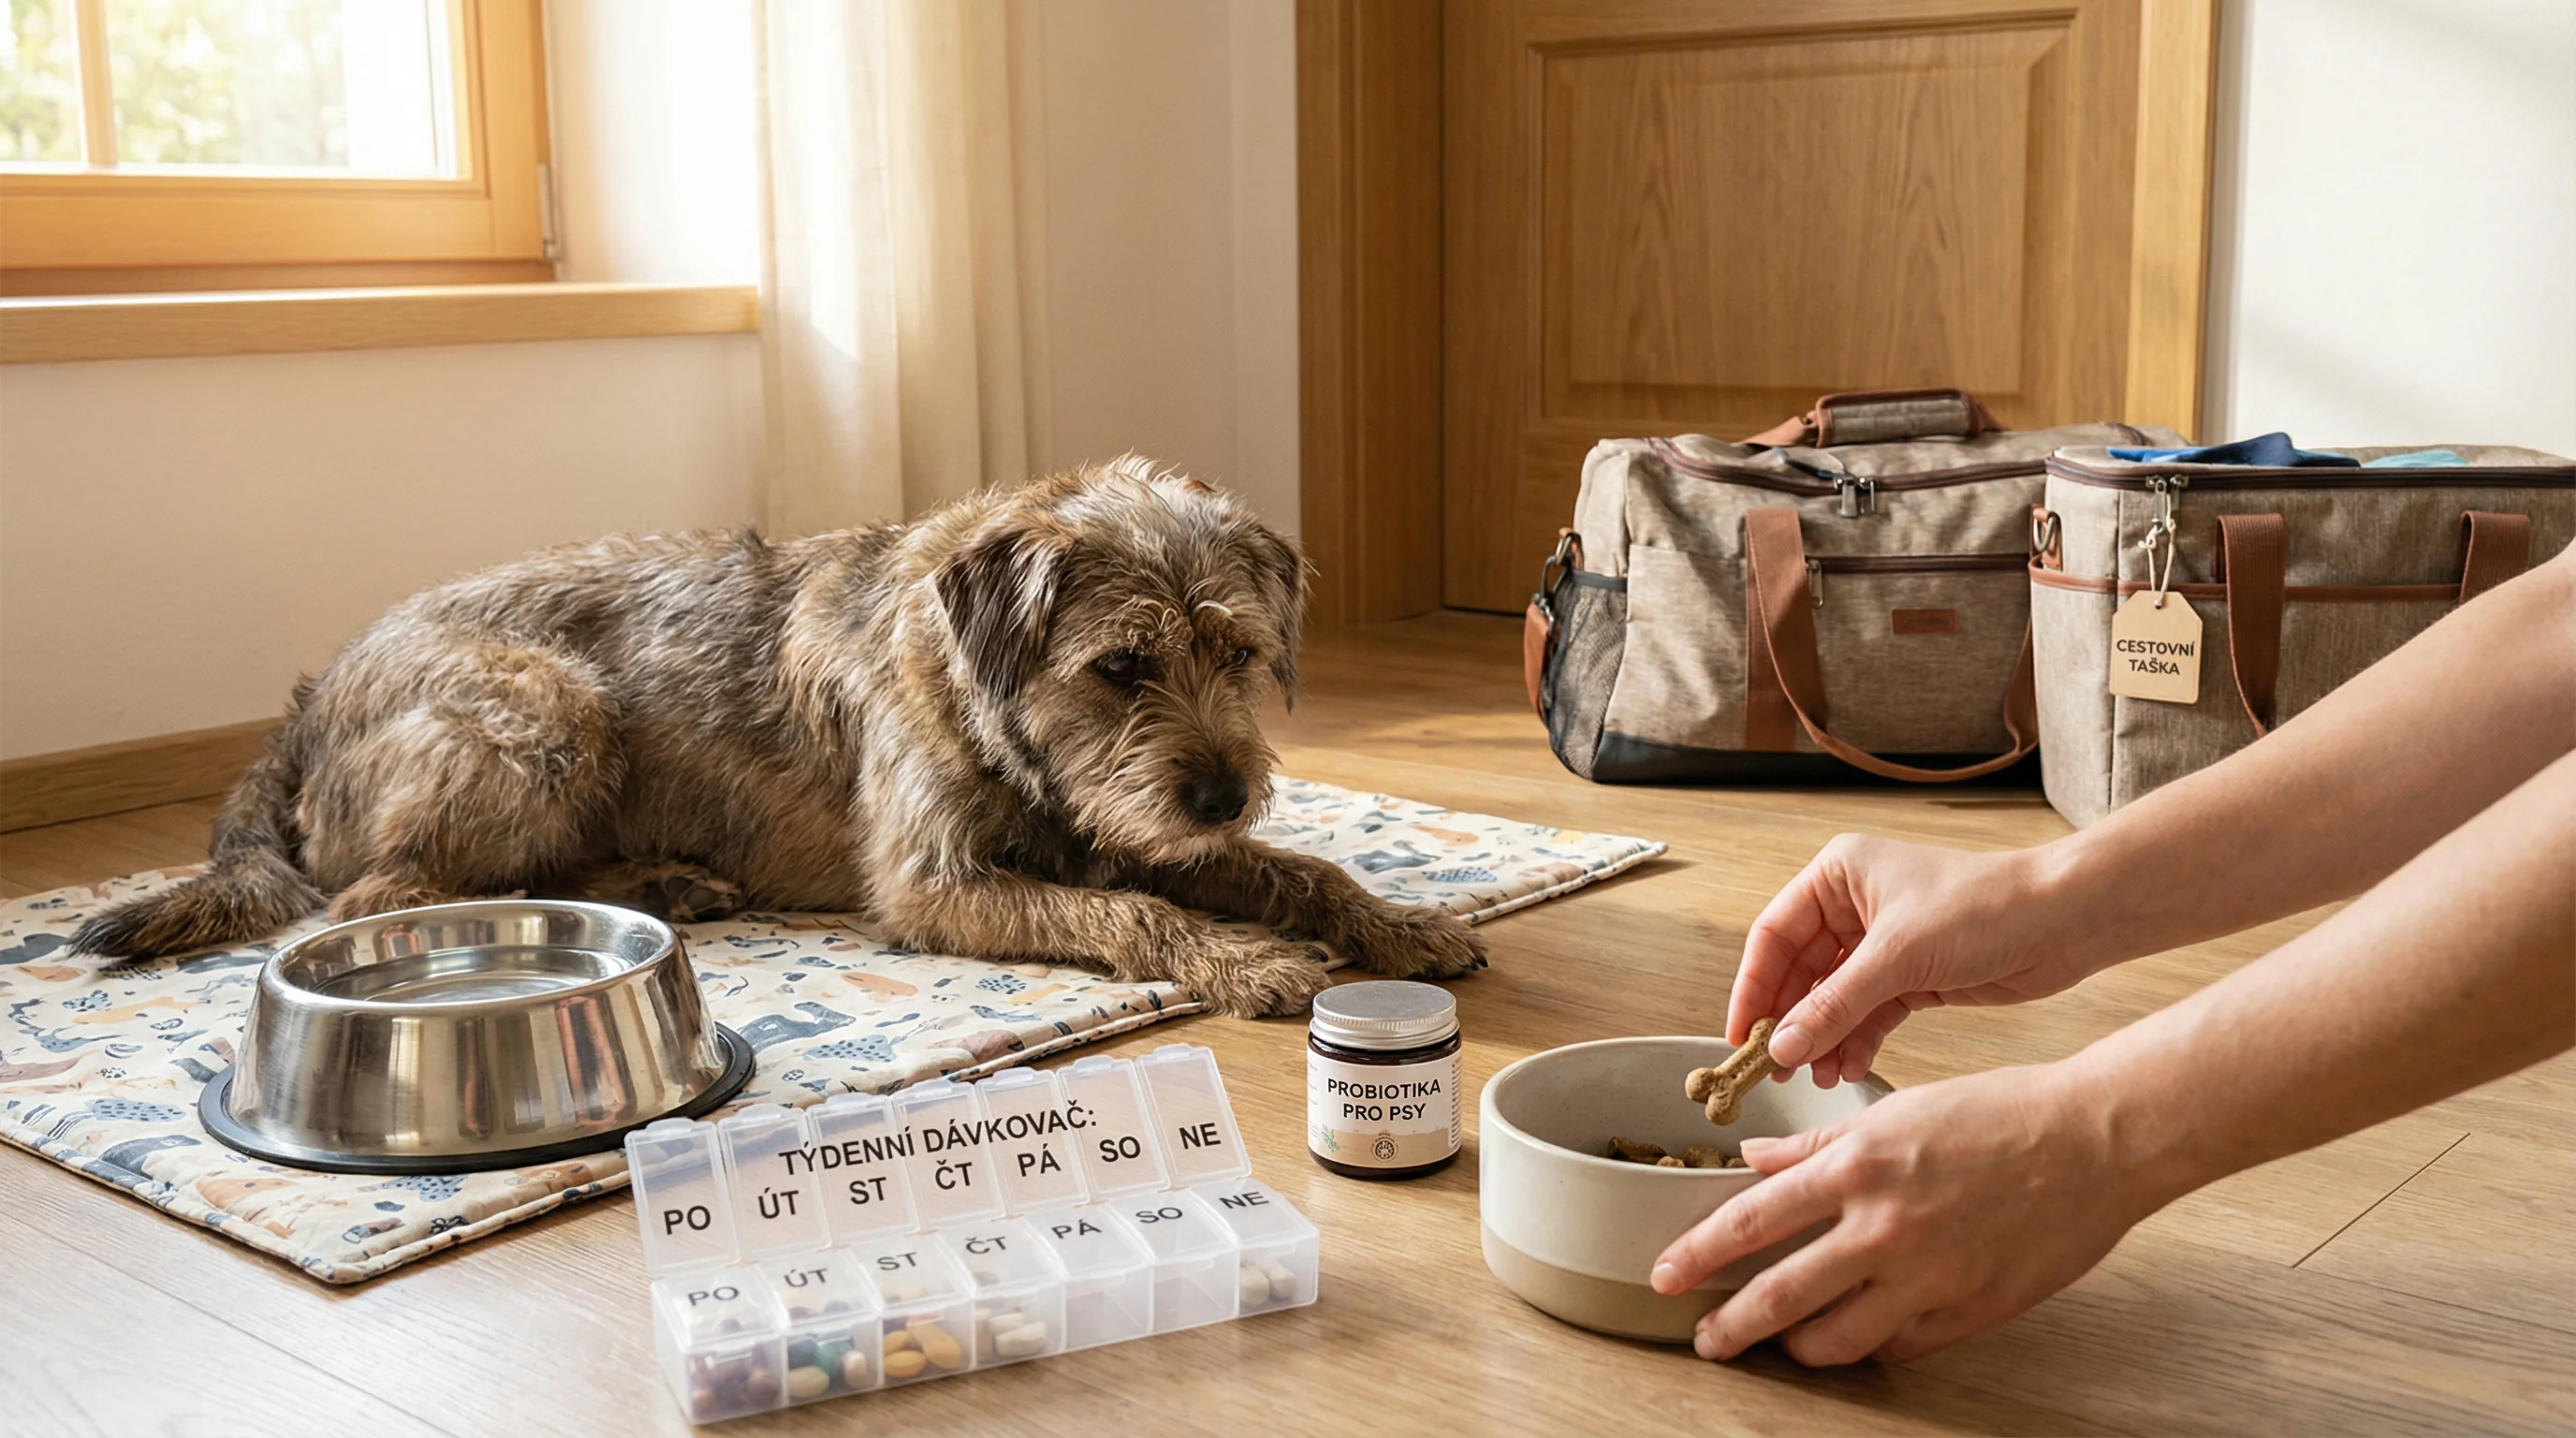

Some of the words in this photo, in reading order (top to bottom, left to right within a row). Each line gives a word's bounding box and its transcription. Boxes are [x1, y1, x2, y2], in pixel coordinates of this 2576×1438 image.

[2116, 639, 2195, 657] CESTOVNÍ
[2129, 657, 2180, 675] TAŠKA
[1327, 1078, 1442, 1100] PROBIOTIKA
[1343, 1103, 1383, 1122] PRO
[1389, 1103, 1427, 1122] PSY
[779, 1125, 915, 1176] TÝDENNÍ
[923, 1099, 1097, 1153] DÁVKOVAČ:
[664, 1205, 711, 1235] PO
[757, 1186, 799, 1220] ÚT
[849, 1176, 887, 1205] ST
[934, 1159, 973, 1191] ČT
[1017, 1143, 1062, 1178] PÁ
[1099, 1136, 1141, 1163] SO
[1178, 1123, 1222, 1150] NE
[687, 1285, 740, 1307] PO
[783, 1268, 828, 1288] ÚT
[876, 1252, 918, 1271] ST
[965, 1236, 1007, 1255] ČT
[1051, 1219, 1103, 1240] PÁ
[1135, 1207, 1184, 1224] SO
[1219, 1192, 1269, 1210] NE
